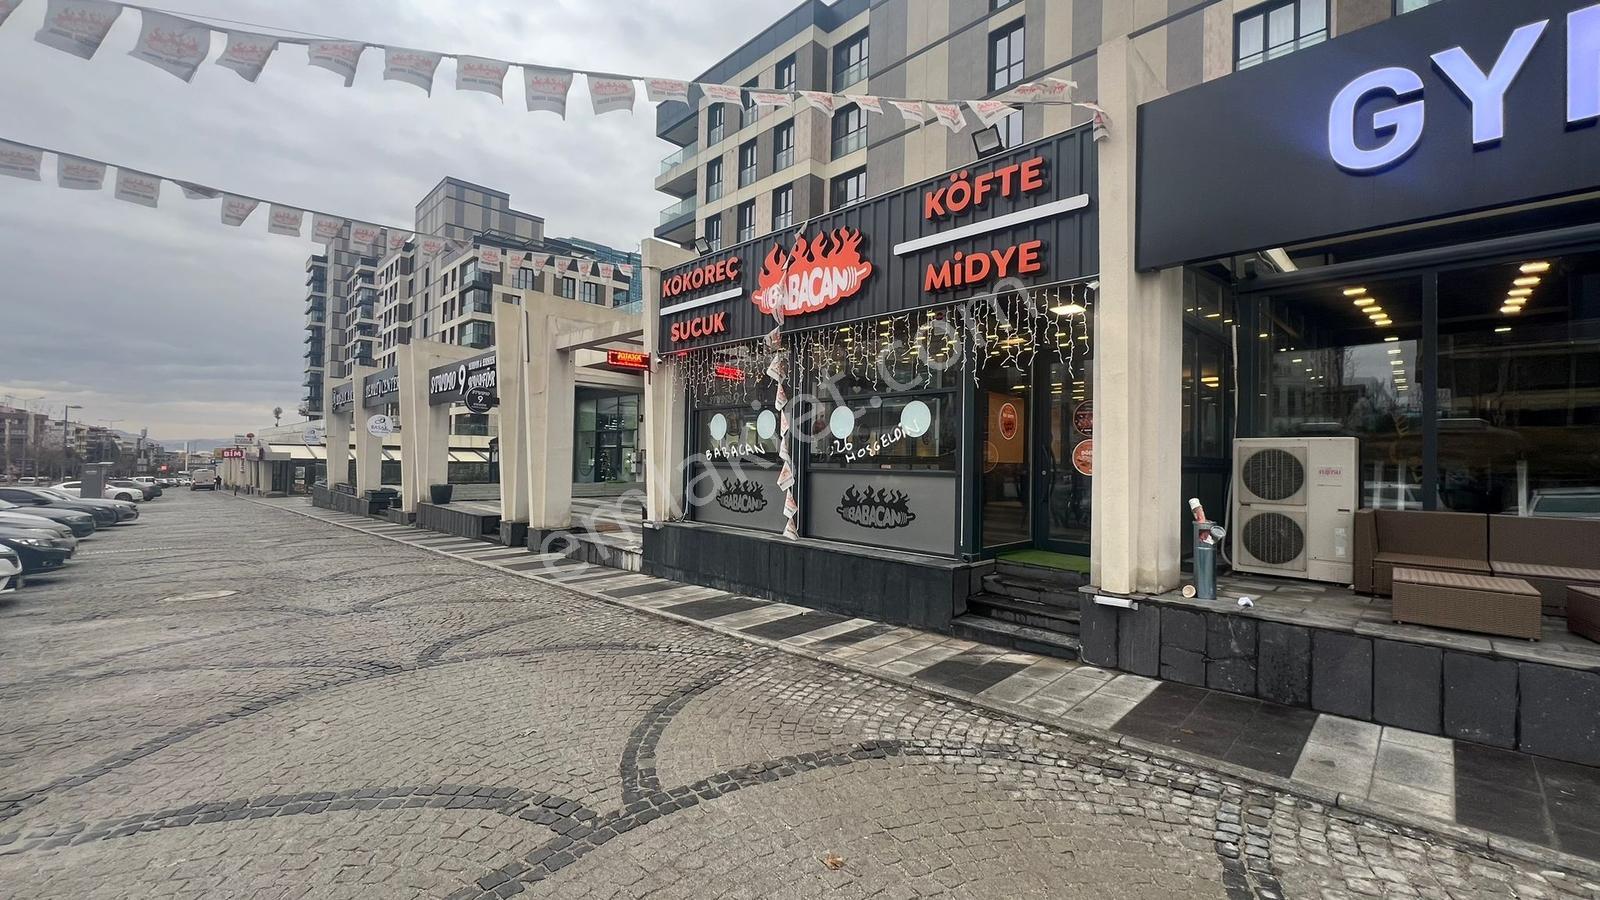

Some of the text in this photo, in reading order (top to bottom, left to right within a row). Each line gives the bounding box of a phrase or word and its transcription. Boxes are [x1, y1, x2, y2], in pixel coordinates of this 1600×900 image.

[924, 156, 1044, 219] KÖFTE
[662, 256, 740, 298] KOKOREÇ
[670, 311, 726, 343] SUCUK
[458, 364, 467, 395] 9
[705, 442, 766, 461] BABACAN
[723, 492, 760, 513] BABACAN
[849, 504, 902, 528] BABACAN
